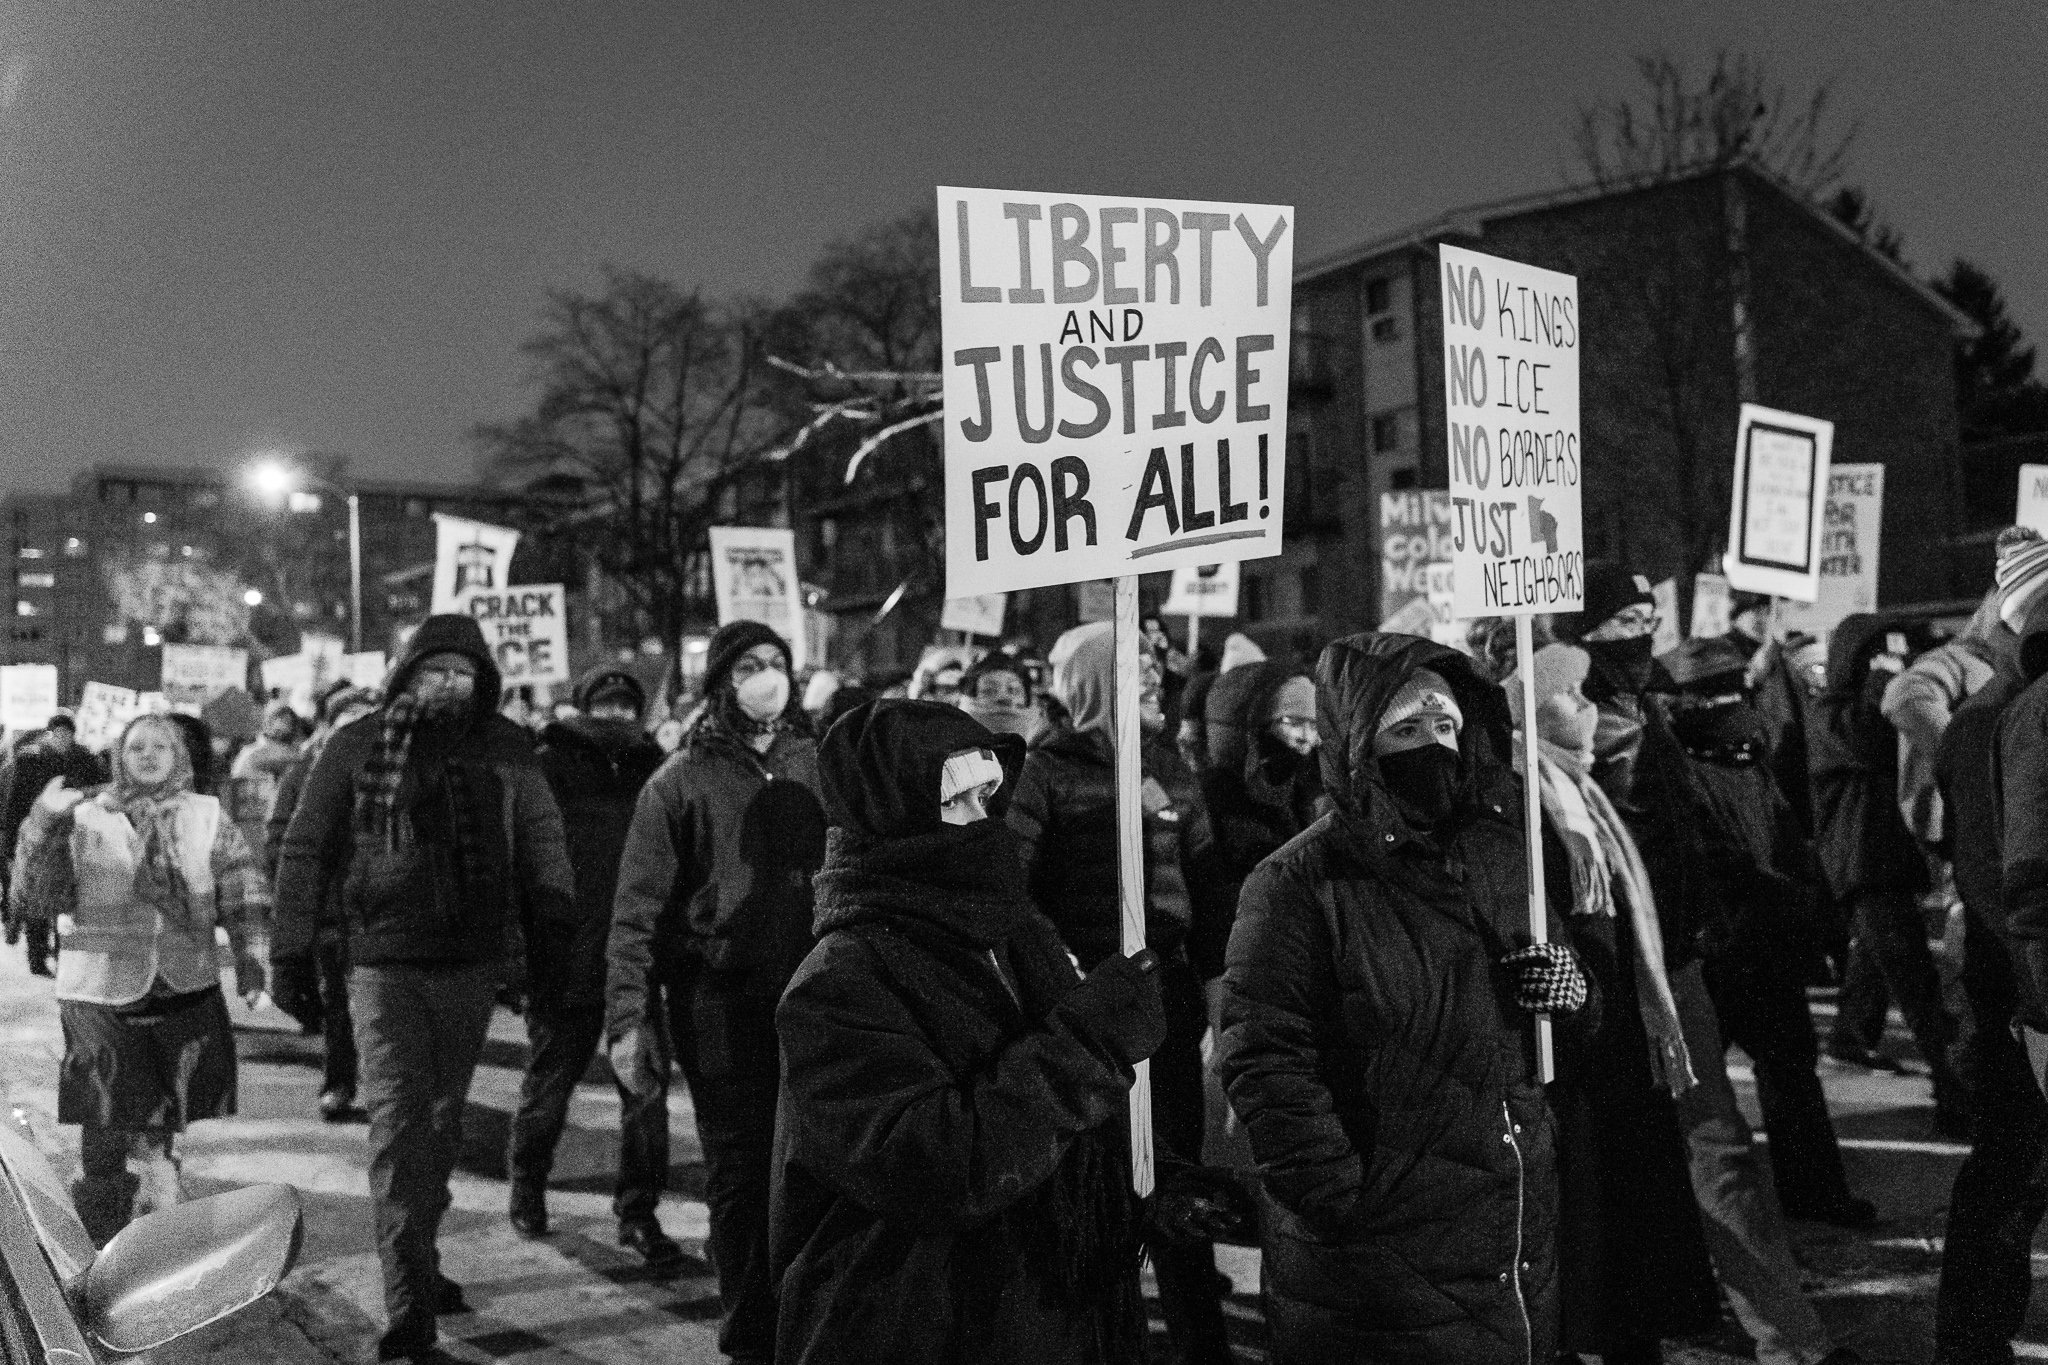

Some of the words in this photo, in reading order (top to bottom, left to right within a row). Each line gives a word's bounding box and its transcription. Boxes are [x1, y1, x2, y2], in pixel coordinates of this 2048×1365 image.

[957, 200, 1288, 307] LIBERTY
[1059, 309, 1144, 345] AND
[1446, 262, 1486, 331] NO
[1496, 278, 1576, 348] KINGS
[954, 334, 1274, 444] JUSTICE
[1449, 344, 1488, 408] NO
[1497, 355, 1551, 415] ICE
[1451, 422, 1491, 491] NO
[1500, 427, 1578, 488] BORDERS
[1827, 473, 1875, 497] STICE
[971, 455, 1098, 562] FOR
[1125, 433, 1270, 542] ALL!
[1452, 497, 1517, 558] JUST
[470, 592, 555, 619] CRACK
[1483, 550, 1584, 608] NEIGHBORS
[496, 622, 531, 637] THE
[496, 638, 554, 677] CE
